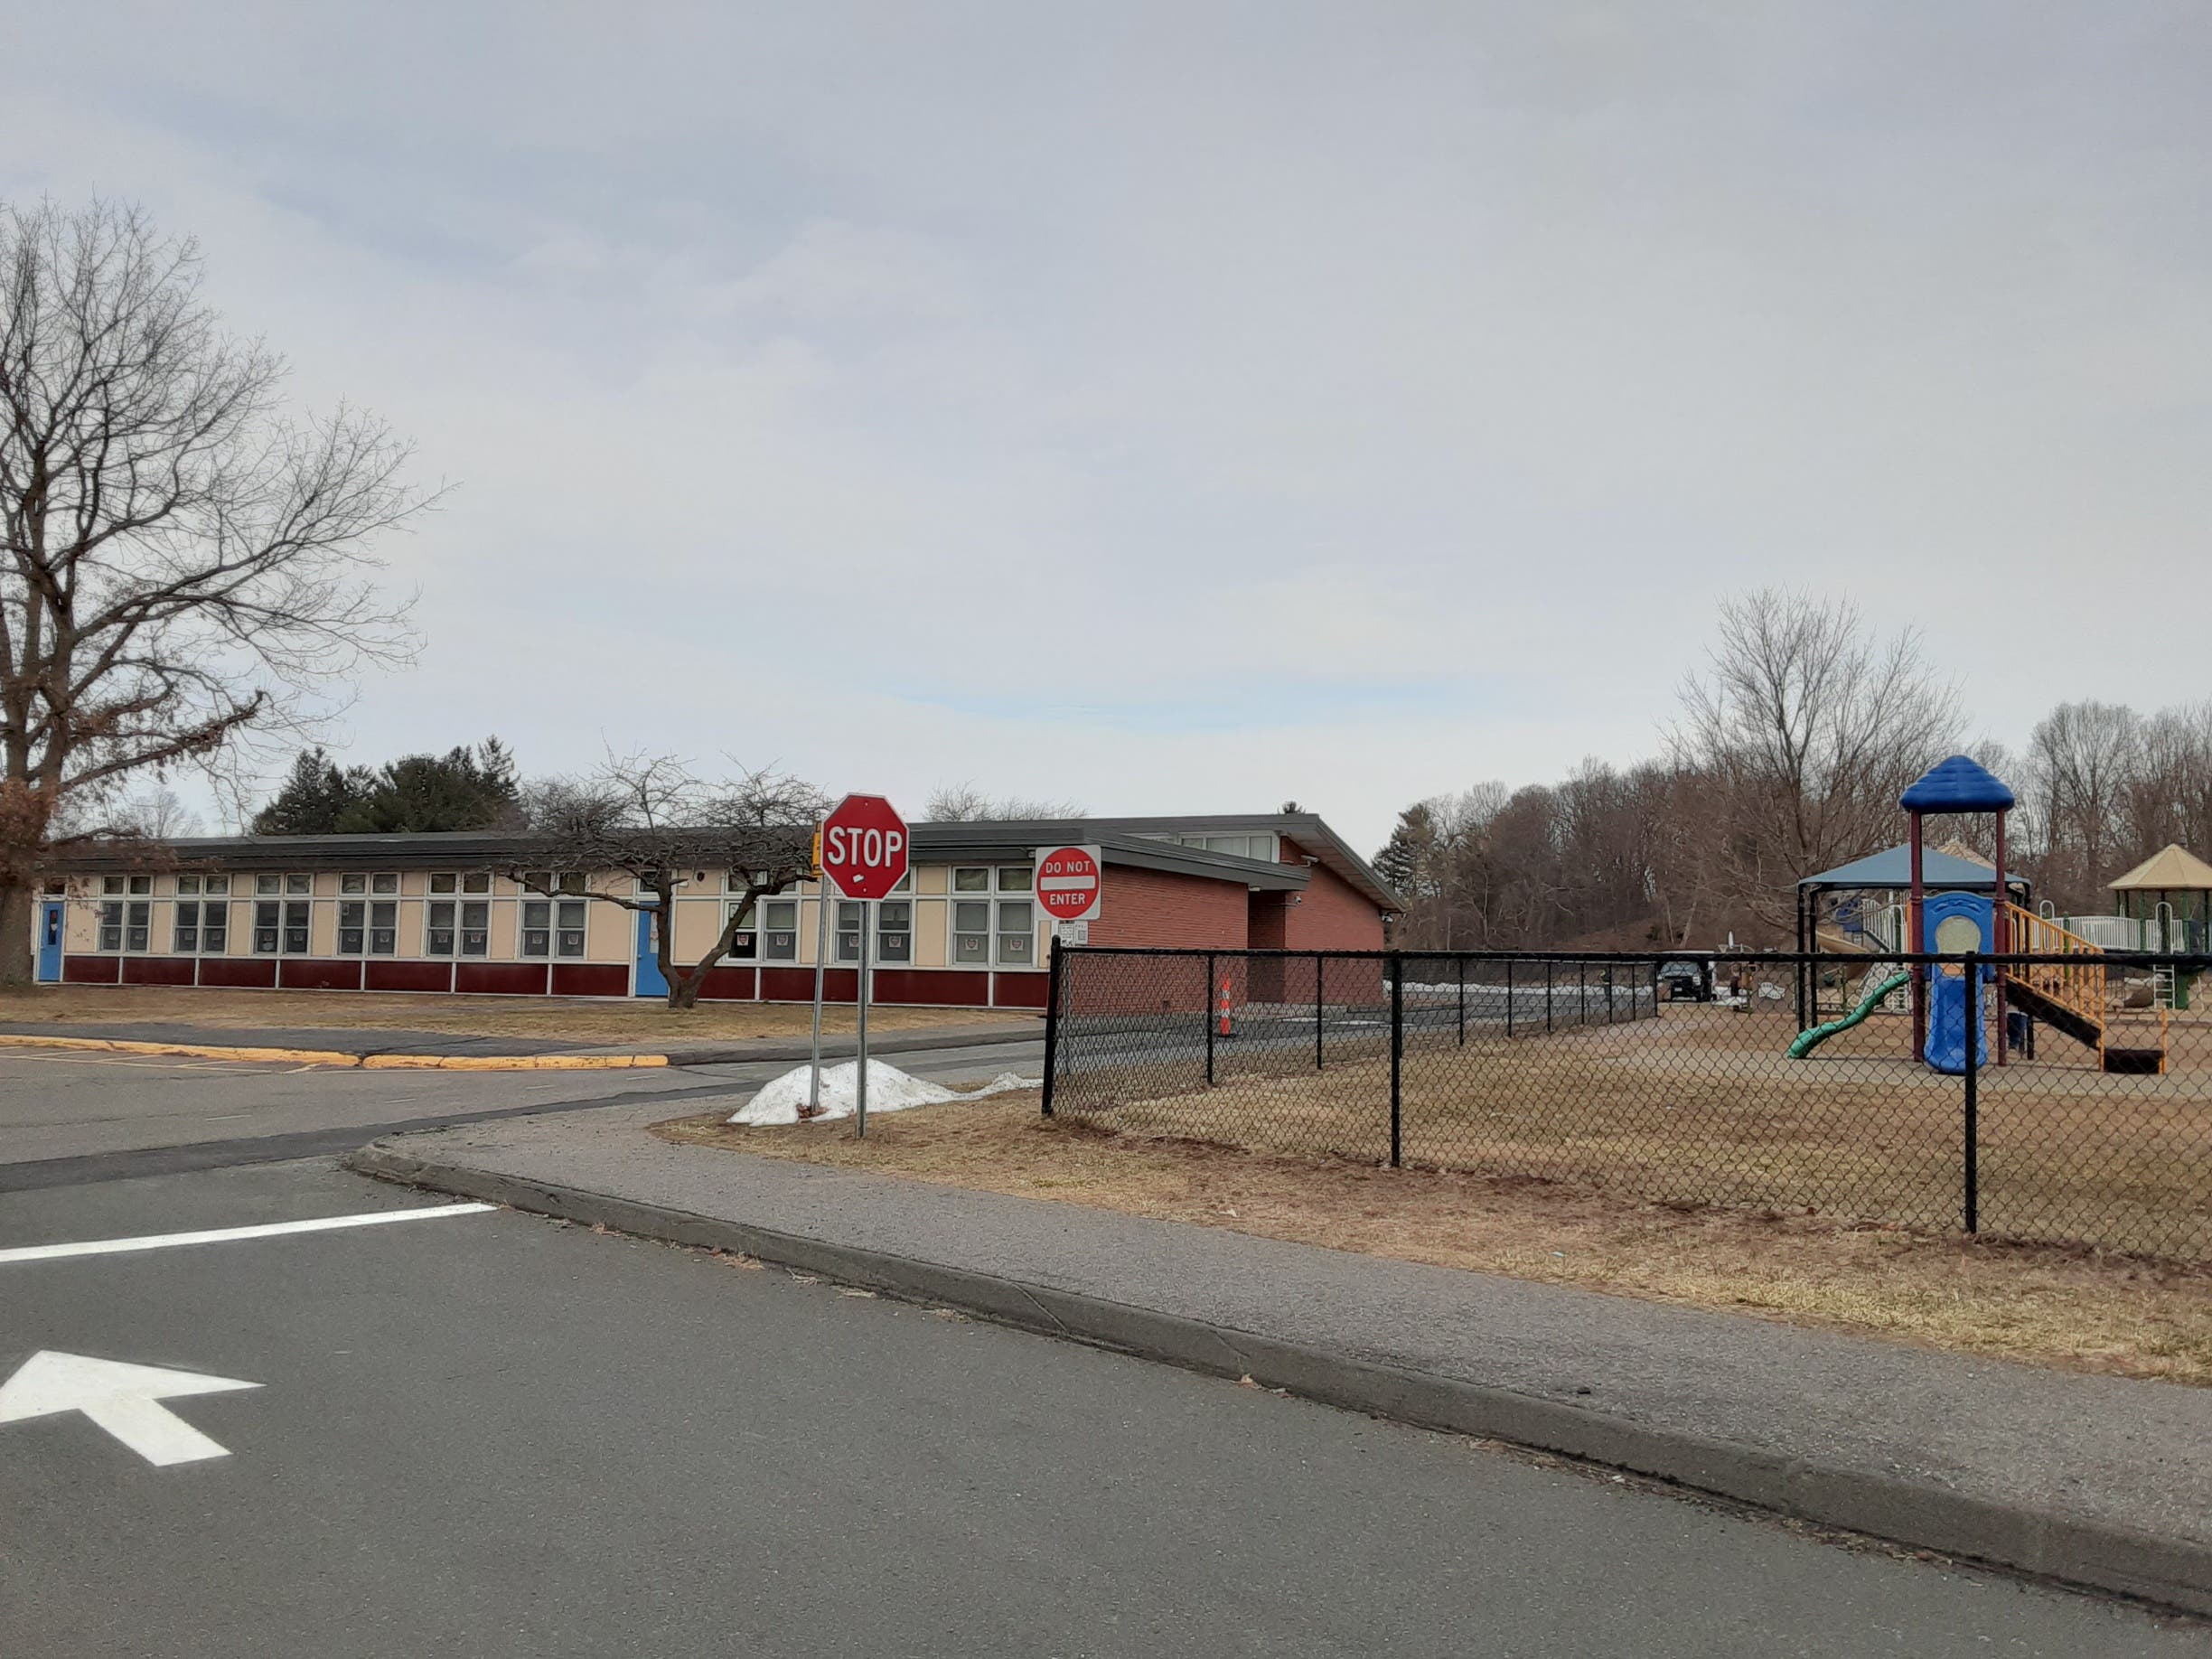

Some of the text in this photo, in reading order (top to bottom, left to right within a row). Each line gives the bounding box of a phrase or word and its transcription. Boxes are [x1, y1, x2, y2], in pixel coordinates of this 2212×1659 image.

[828, 826, 903, 867] STOP
[1045, 860, 1091, 874] DO NOT
[1049, 893, 1086, 905] ENTER
